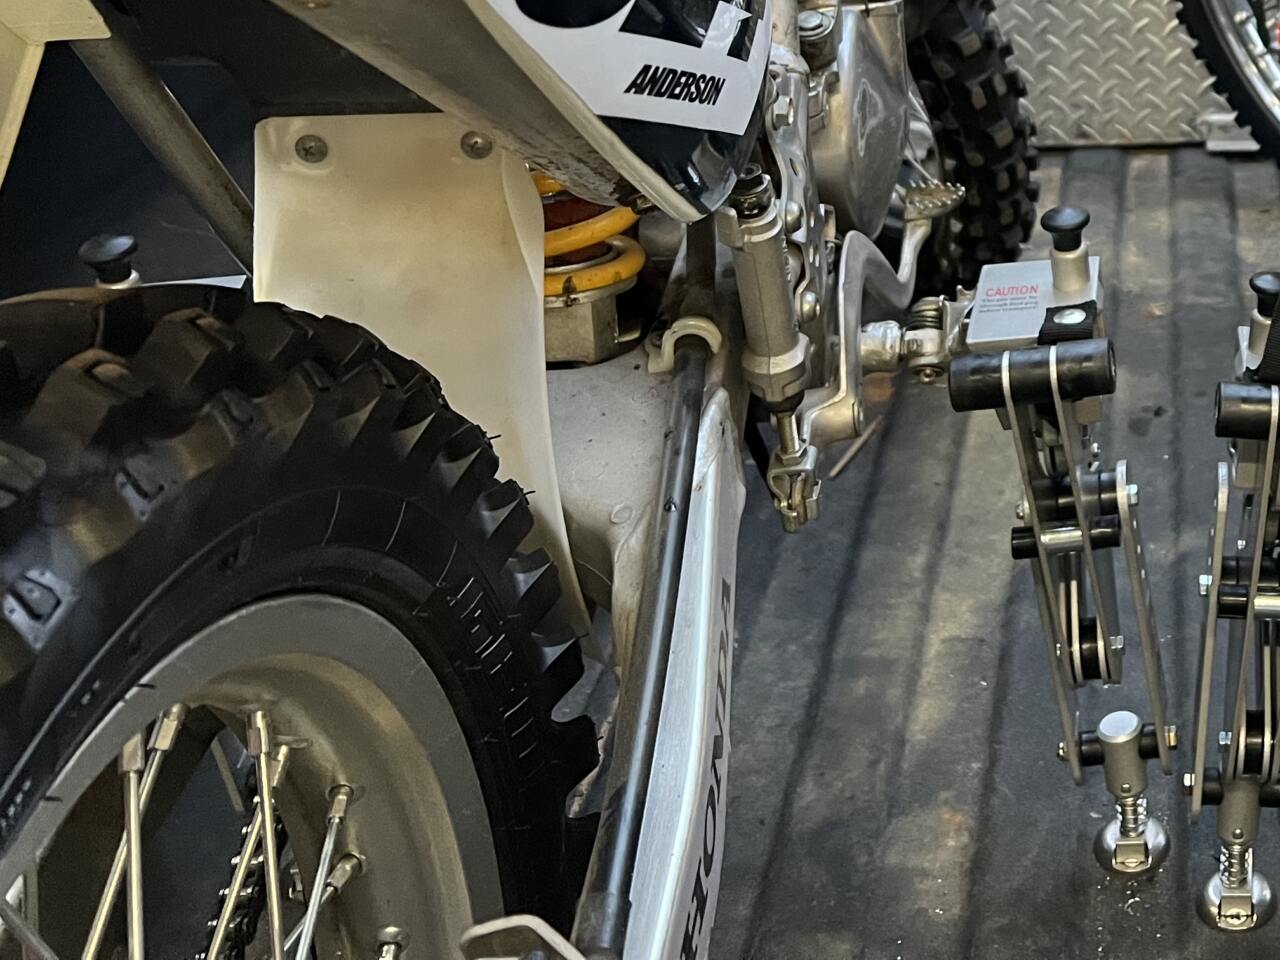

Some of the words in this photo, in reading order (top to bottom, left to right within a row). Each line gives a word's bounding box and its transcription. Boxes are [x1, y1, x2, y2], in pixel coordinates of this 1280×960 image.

[623, 63, 726, 106] ANDERSON
[985, 284, 1040, 298] CAUTION
[679, 577, 731, 960] HONDA
